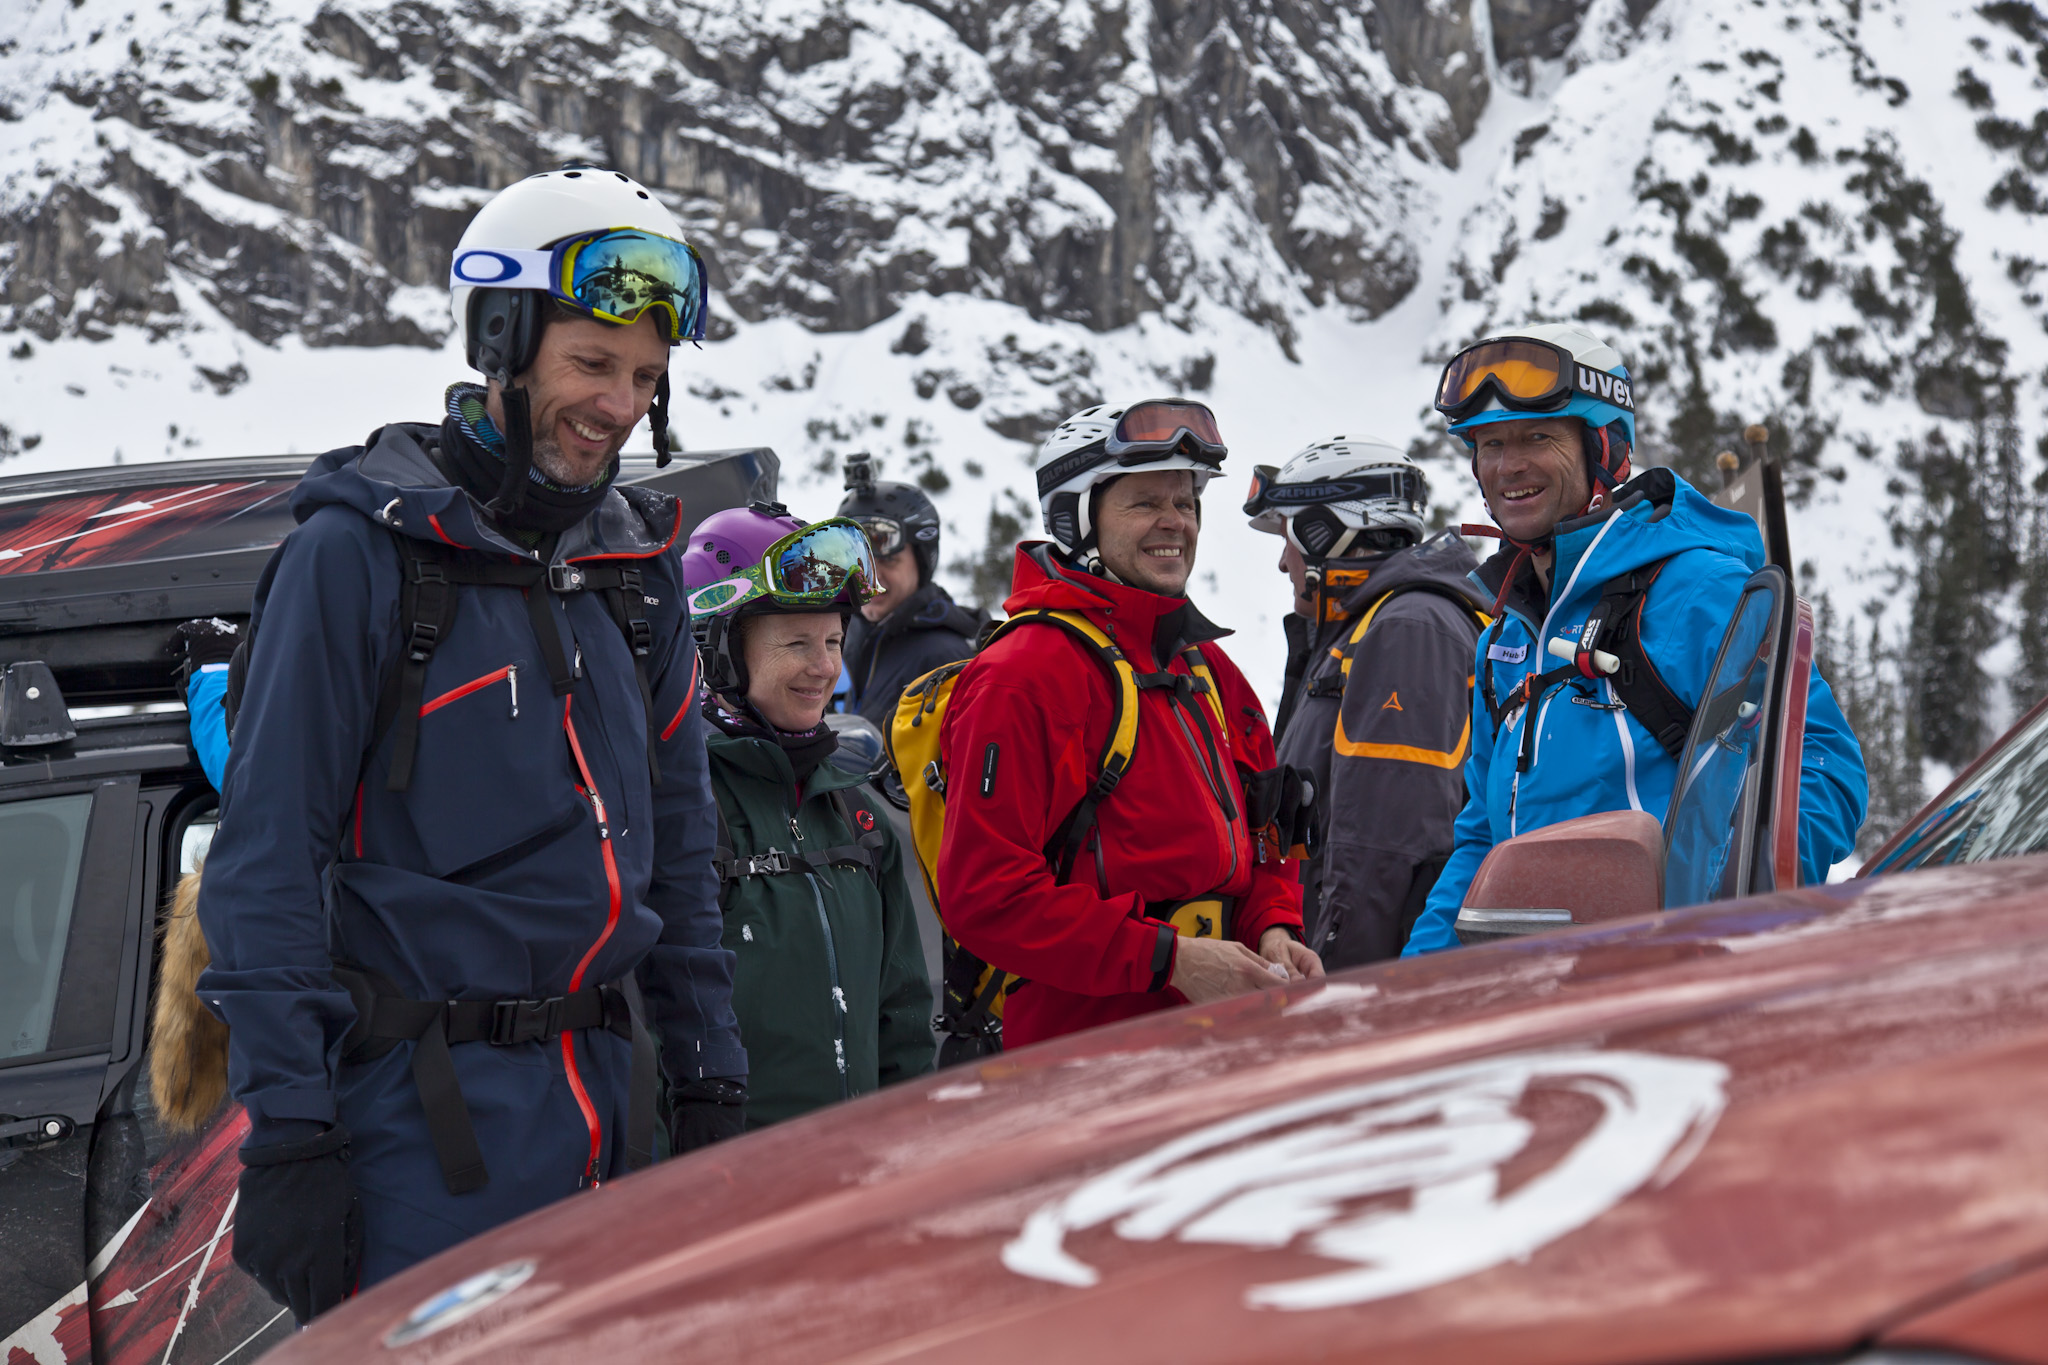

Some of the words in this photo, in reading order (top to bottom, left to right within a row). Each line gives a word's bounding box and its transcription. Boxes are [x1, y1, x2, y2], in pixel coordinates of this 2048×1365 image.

[1578, 366, 1634, 409] uvex
[1040, 451, 1100, 488] ALPINA
[1273, 485, 1345, 498] ALPINA
[1581, 619, 1597, 650] ABS
